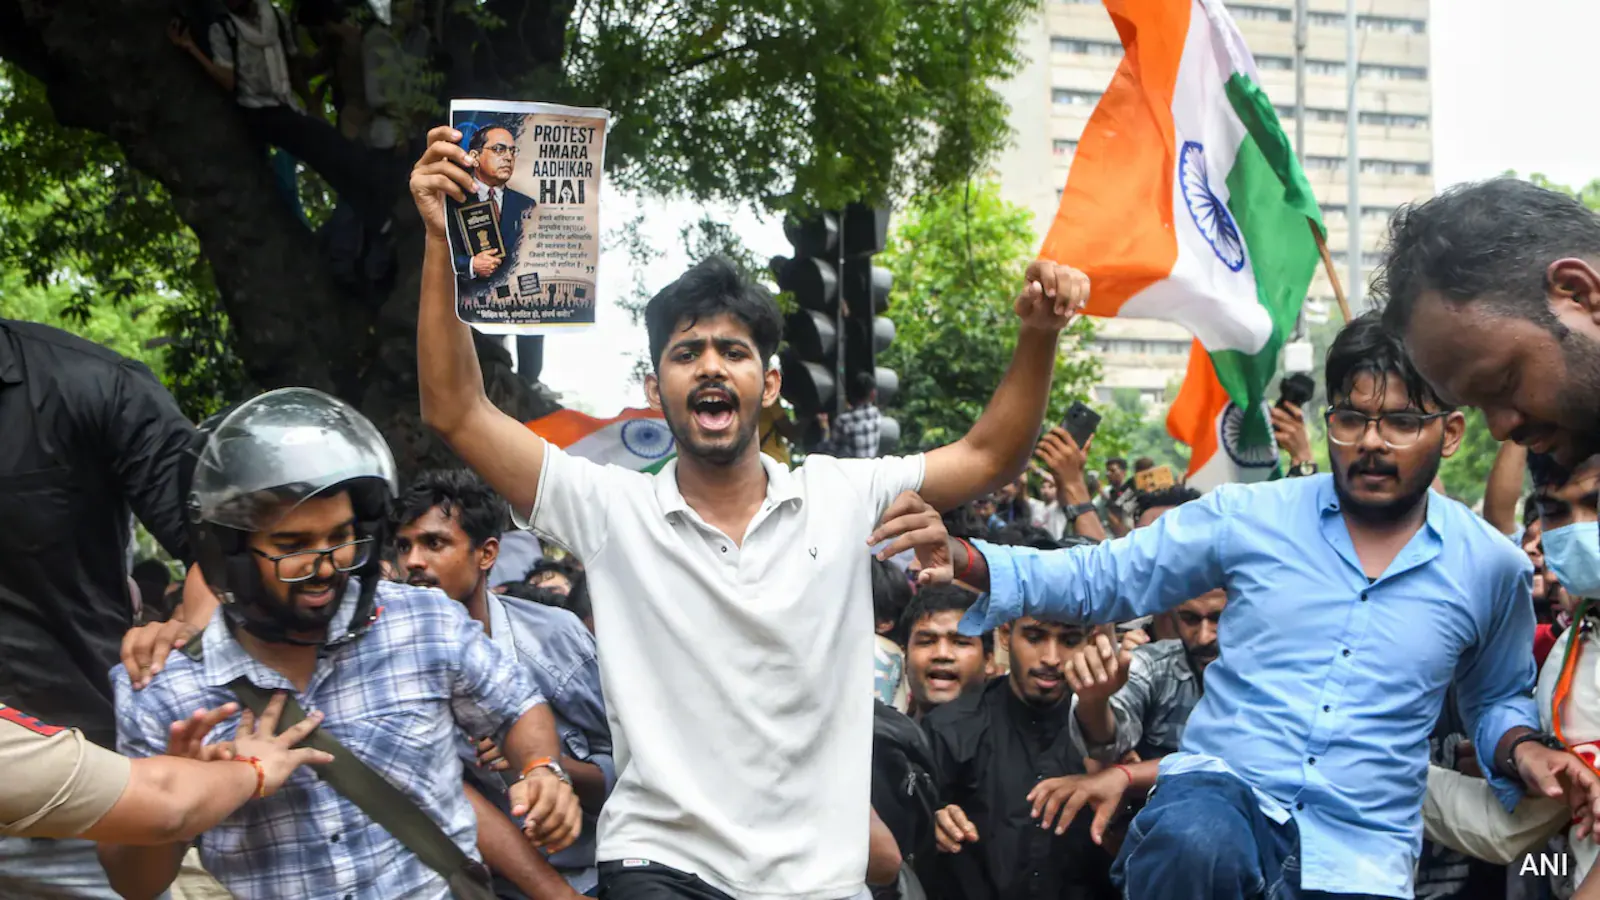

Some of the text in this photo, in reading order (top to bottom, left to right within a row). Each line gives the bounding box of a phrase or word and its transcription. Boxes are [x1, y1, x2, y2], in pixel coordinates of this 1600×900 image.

[534, 125, 596, 144] PROTEST
[539, 144, 588, 159] HMARA
[533, 161, 593, 178] AADHIKAR
[540, 179, 585, 204] HAI
